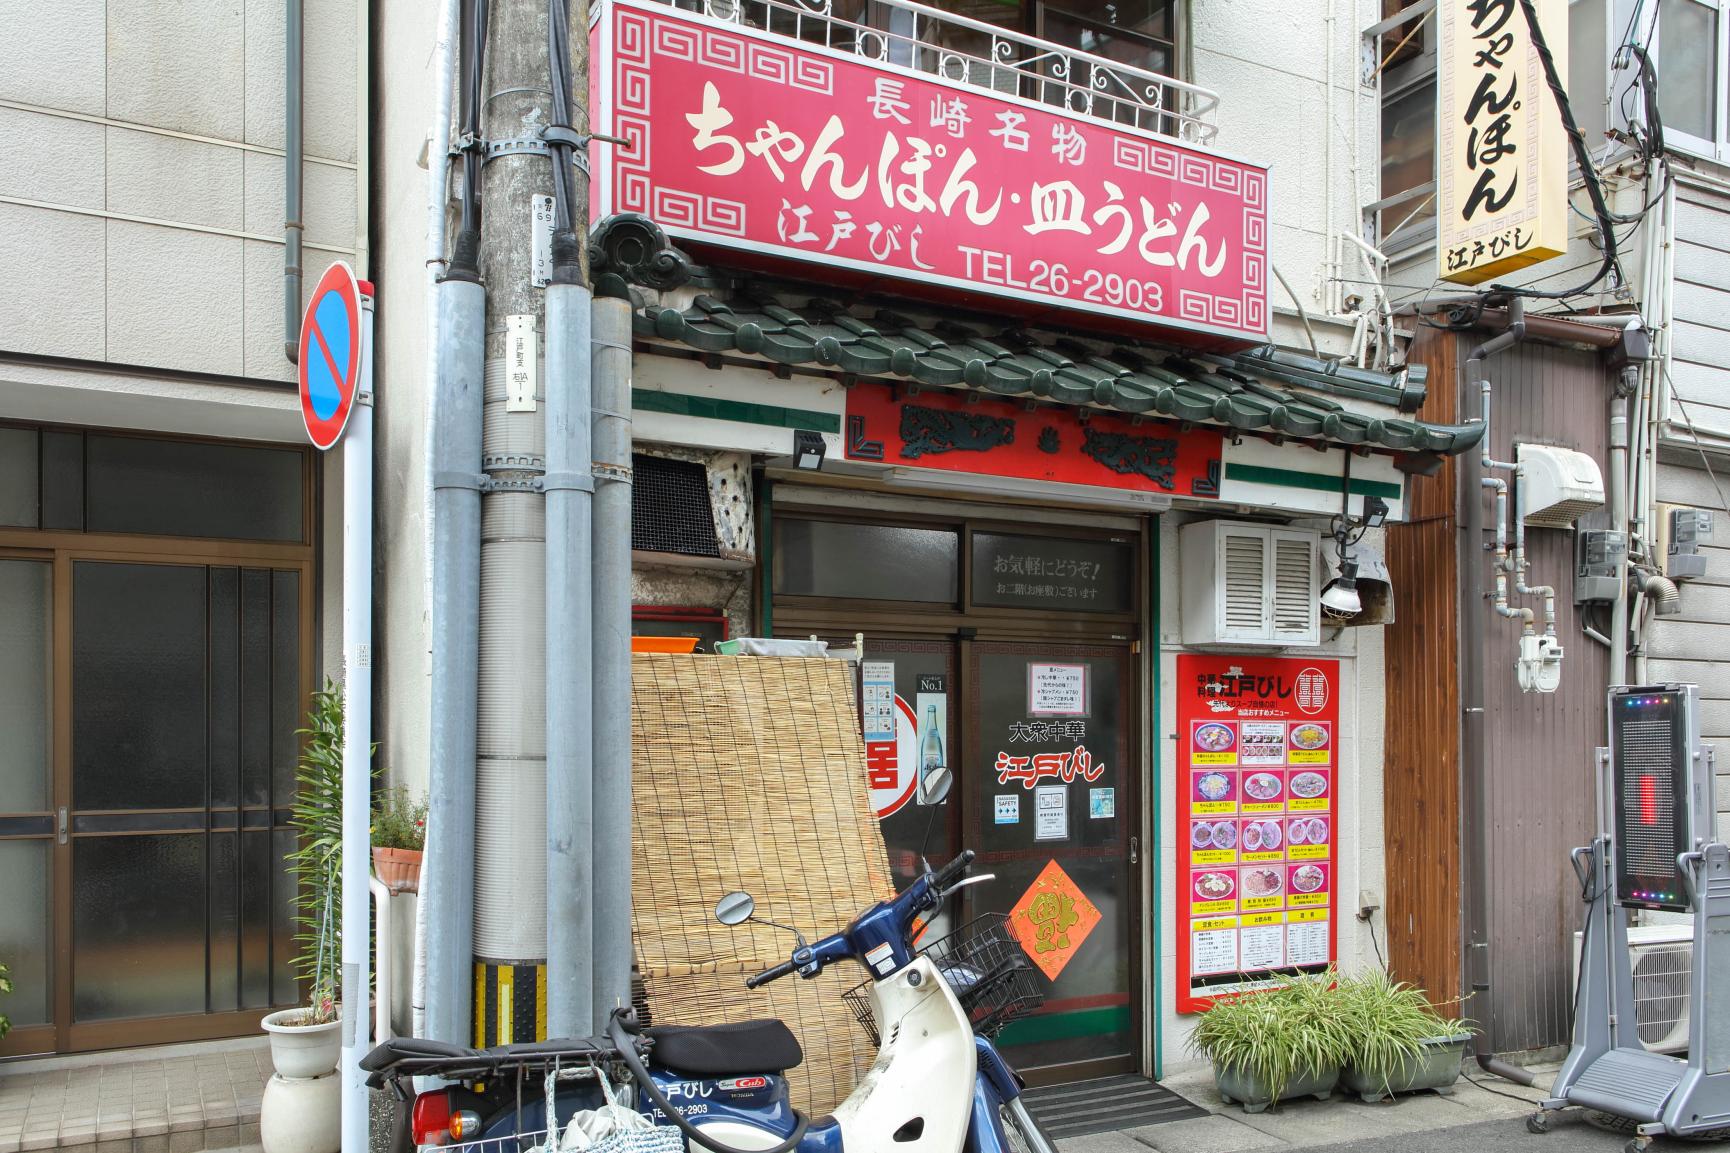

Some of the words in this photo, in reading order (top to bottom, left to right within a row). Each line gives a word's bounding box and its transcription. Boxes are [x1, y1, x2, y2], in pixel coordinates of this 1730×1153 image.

[867, 77, 1087, 166] 長崎名物
[778, 198, 936, 270] 江戸びし
[1447, 227, 1534, 272] 江戸びし
[921, 679, 943, 691] No.1
[1220, 674, 1292, 699] 江戸びし
[1009, 720, 1085, 743] 大衆中華
[995, 745, 1105, 789] 江戸びし
[674, 1104, 708, 1117] 6-2903
